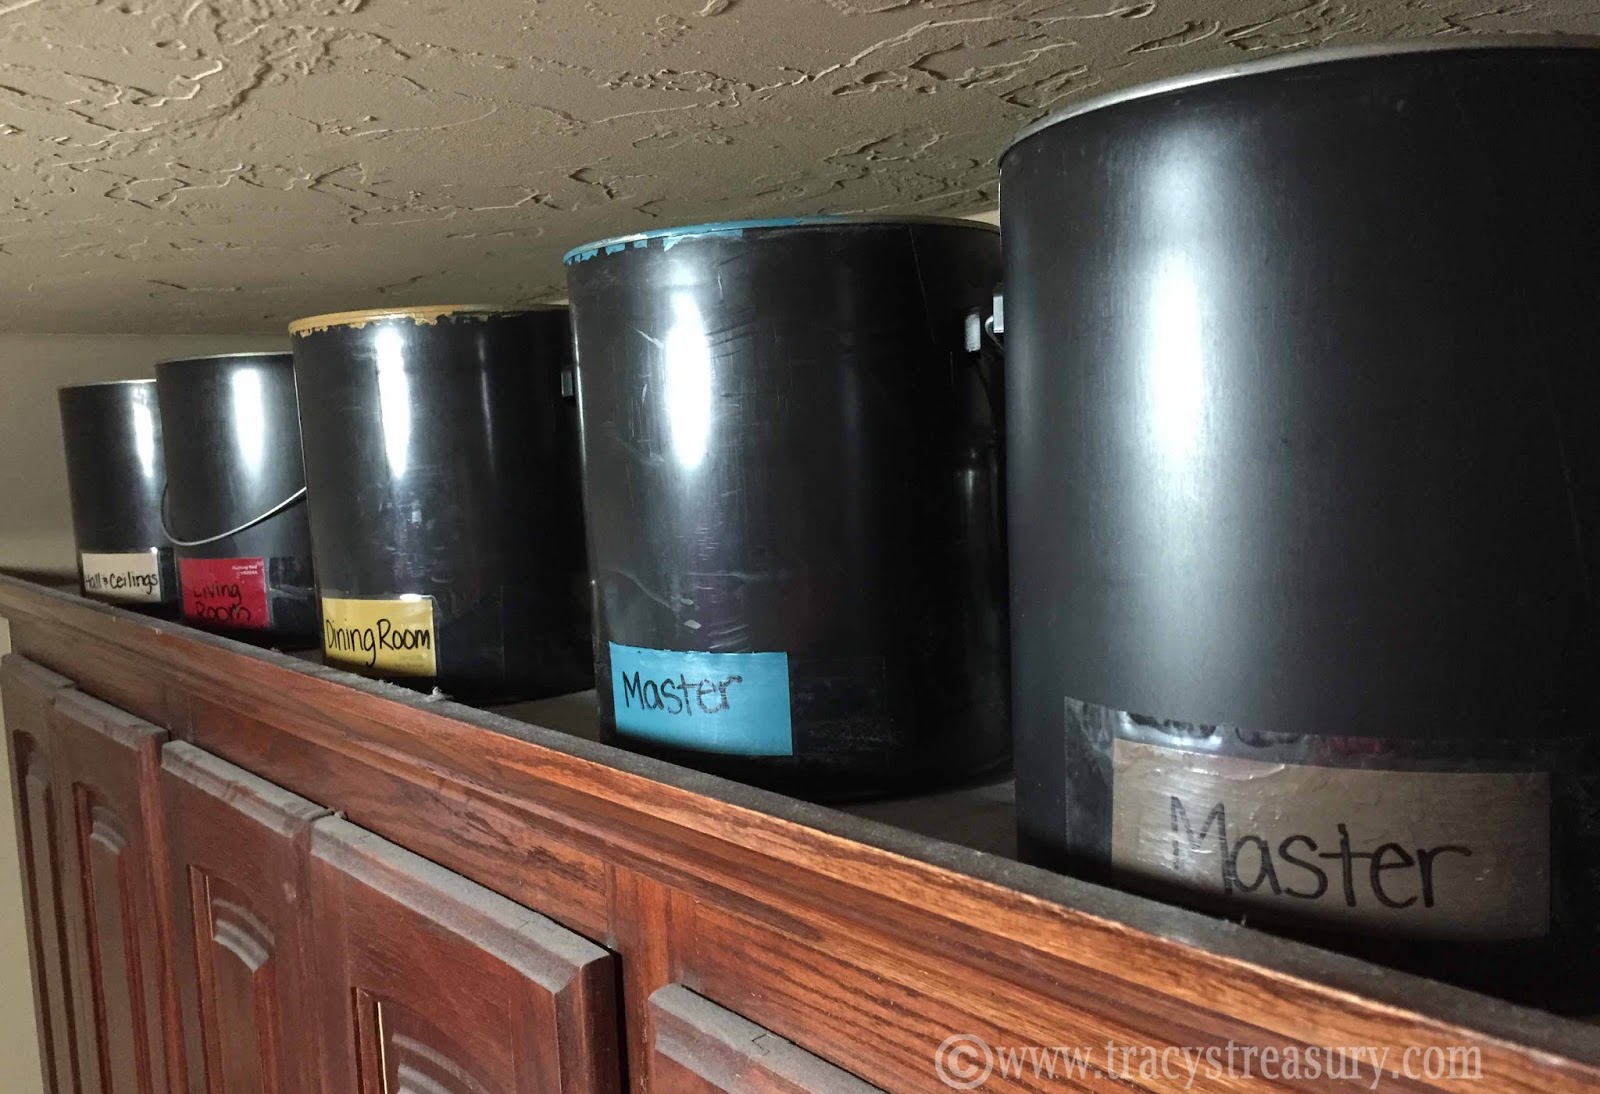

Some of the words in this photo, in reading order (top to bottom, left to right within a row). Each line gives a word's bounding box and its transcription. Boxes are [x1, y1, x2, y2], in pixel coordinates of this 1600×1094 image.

[109, 571, 159, 595] Ceilings
[193, 581, 241, 606] Living
[195, 601, 251, 623] Room
[622, 670, 743, 717] Master
[1169, 794, 1472, 911] Master
